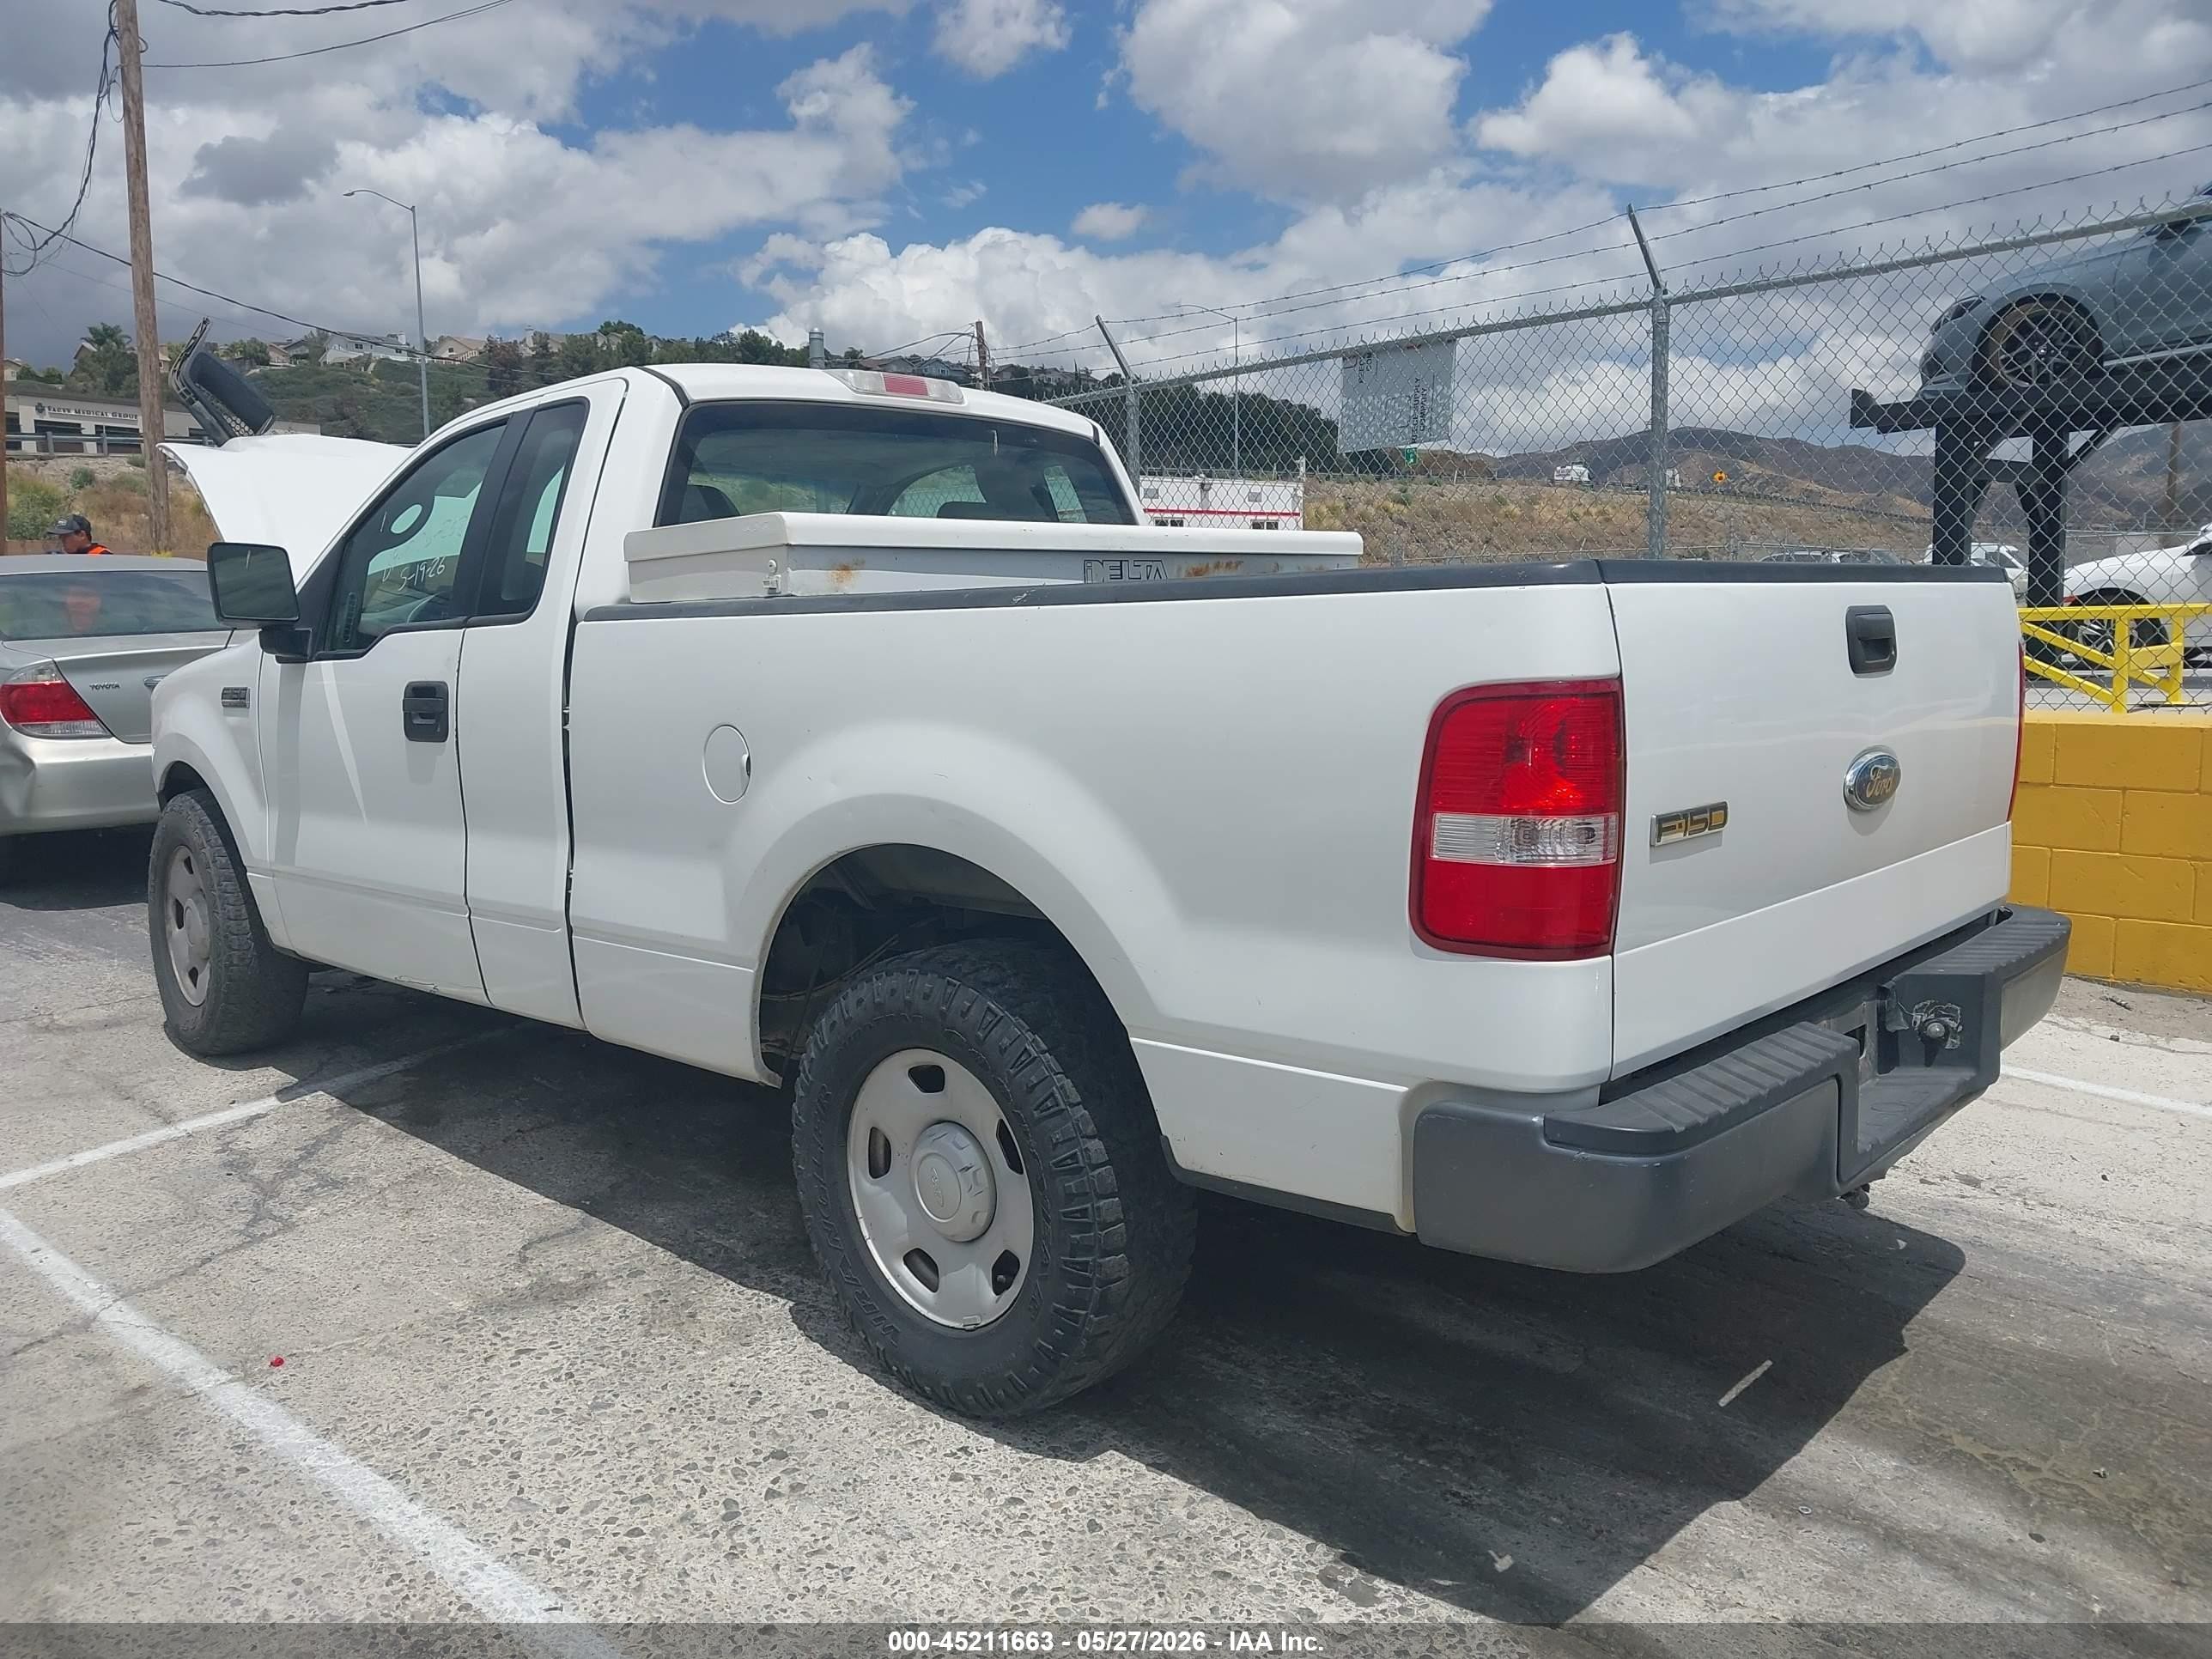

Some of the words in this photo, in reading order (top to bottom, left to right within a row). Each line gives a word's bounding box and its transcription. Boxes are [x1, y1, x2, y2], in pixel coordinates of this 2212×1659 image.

[74, 408, 109, 417] MEDICAL
[1084, 560, 1168, 584] DELTA
[1866, 764, 1898, 799] Ford
